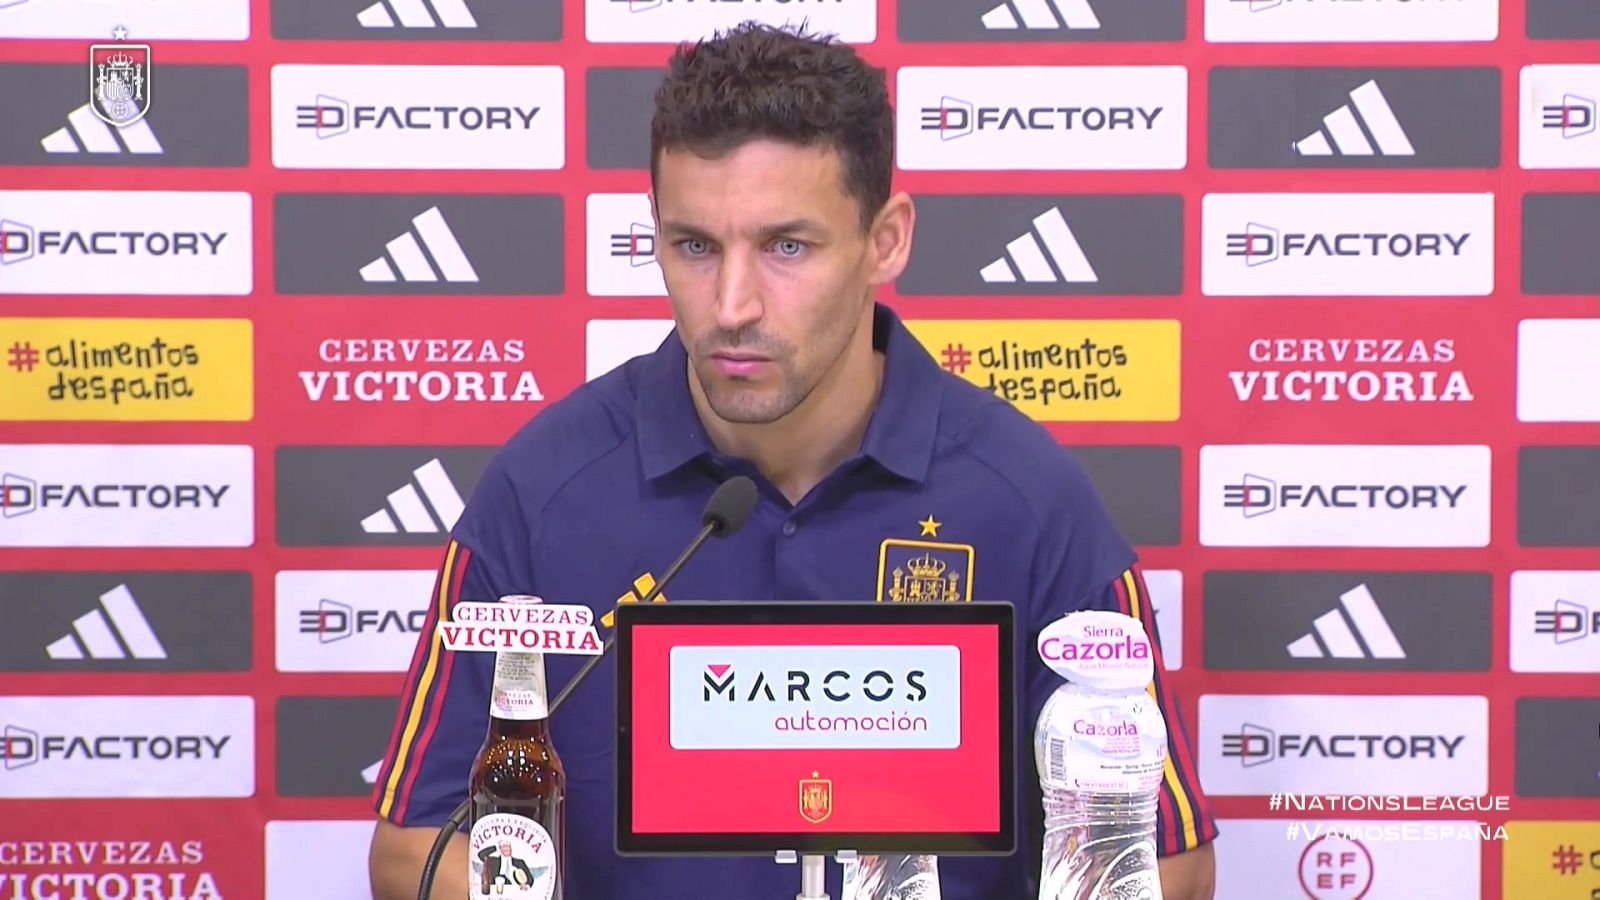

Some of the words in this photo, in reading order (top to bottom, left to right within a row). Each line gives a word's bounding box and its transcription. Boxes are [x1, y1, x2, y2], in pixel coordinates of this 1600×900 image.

[319, 339, 525, 363] CERVEZAS
[1249, 339, 1455, 363] CERVEZAS
[48, 371, 194, 404] despaña
[299, 371, 544, 401] VICTORIA
[1229, 371, 1473, 401] VICTORIA
[457, 606, 588, 626] CERVEZAS
[443, 626, 599, 650] VICTORIA
[1083, 625, 1124, 638] Sierra
[1040, 635, 1149, 661] Cazorla
[703, 665, 927, 702] MARCOS
[774, 710, 928, 732] automoción
[1073, 719, 1139, 737] Cazorla
[473, 825, 543, 854] VICTORIA
[0, 841, 204, 865] CERVEZAS
